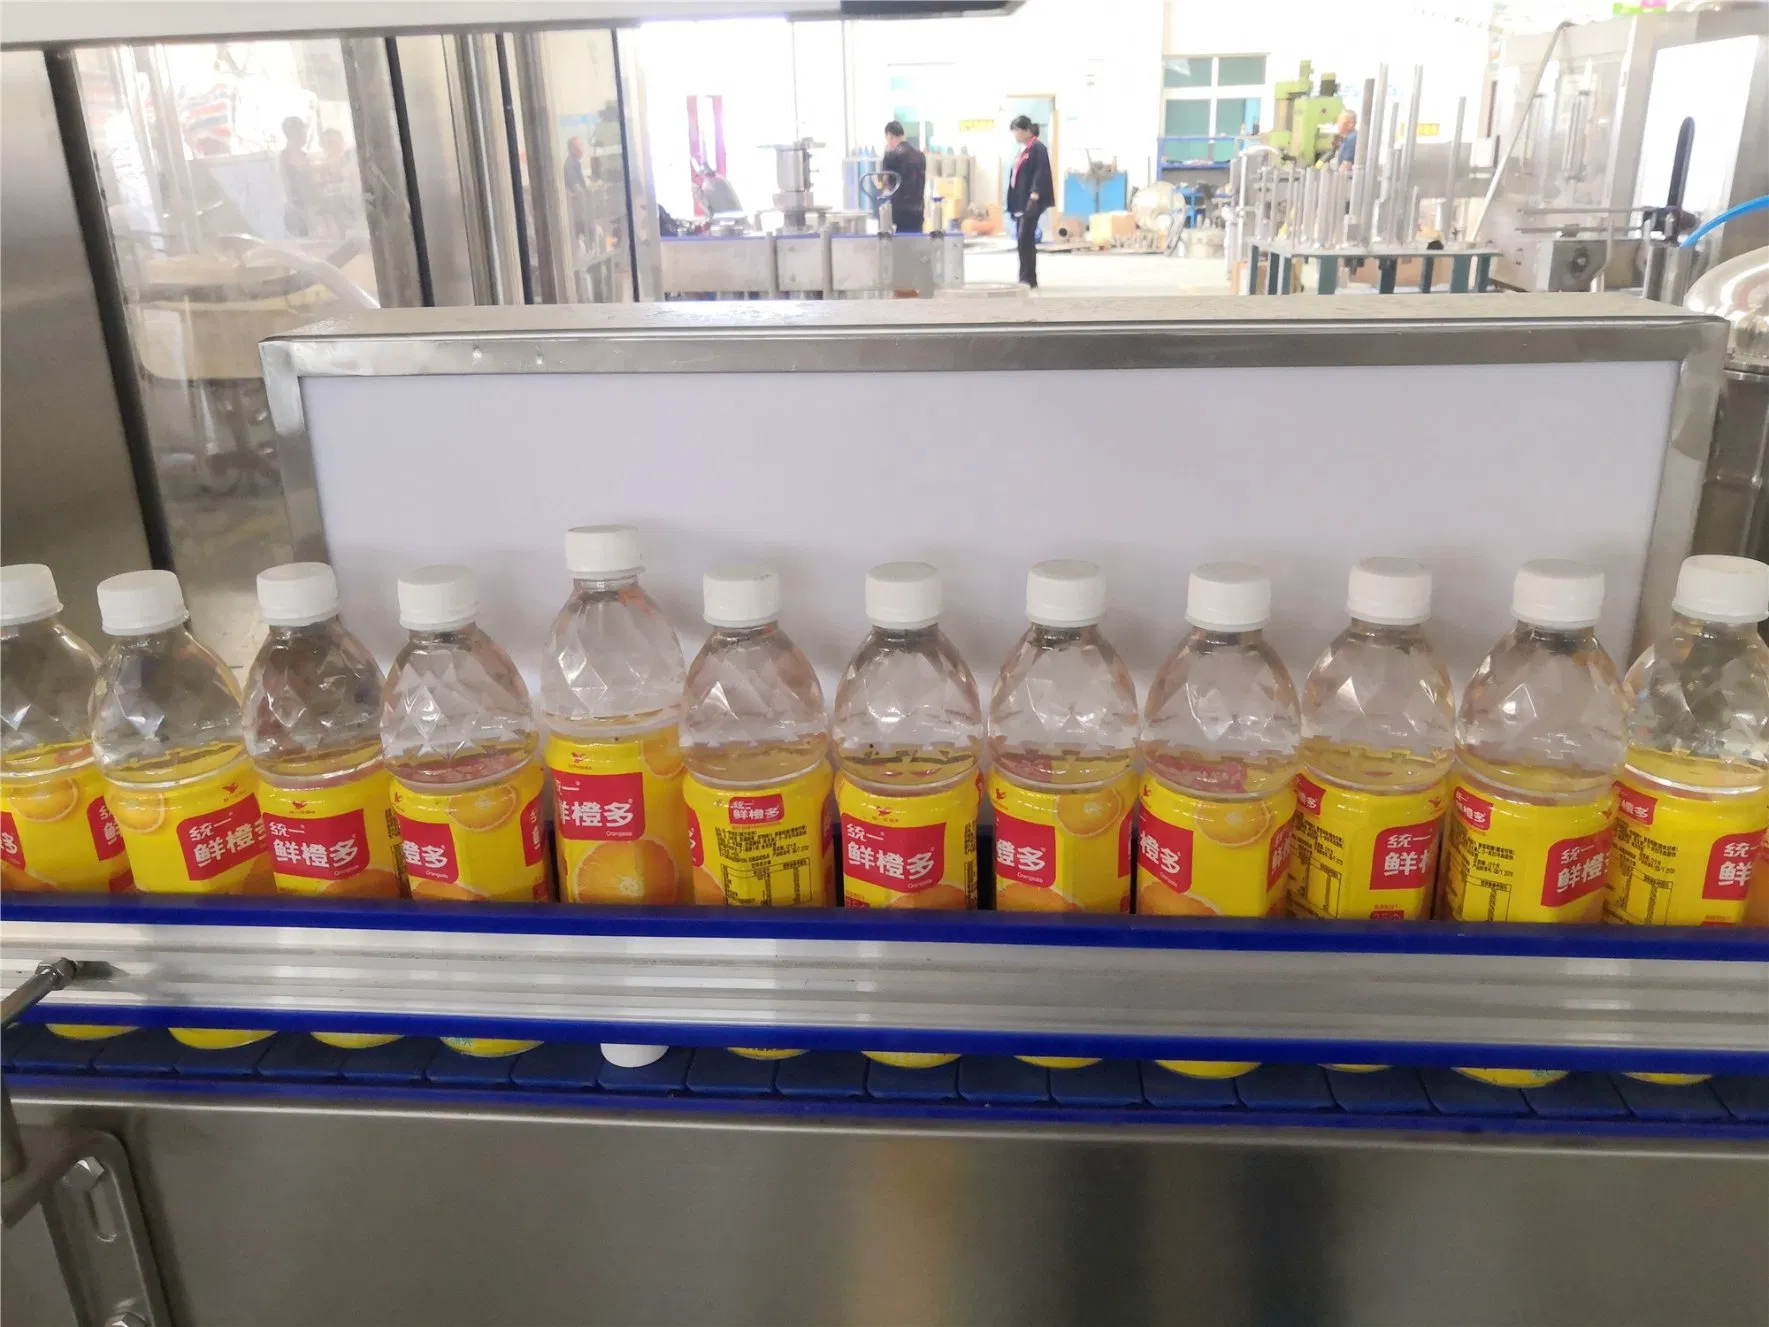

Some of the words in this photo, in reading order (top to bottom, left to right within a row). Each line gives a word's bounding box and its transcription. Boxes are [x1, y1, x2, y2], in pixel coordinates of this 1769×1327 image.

[732, 807, 780, 820] 鲜橙多
[188, 818, 232, 842] 统一
[268, 821, 305, 838] 统一
[846, 823, 884, 842] 统一
[1387, 833, 1431, 849] 统一
[273, 838, 359, 869] 鲜橙多
[847, 840, 935, 880] 鲜橙多
[1140, 830, 1181, 874] 橙多
[1560, 846, 1595, 865] 统一
[1556, 852, 1609, 893] 鲜橙
[1718, 861, 1753, 887] 鲜
